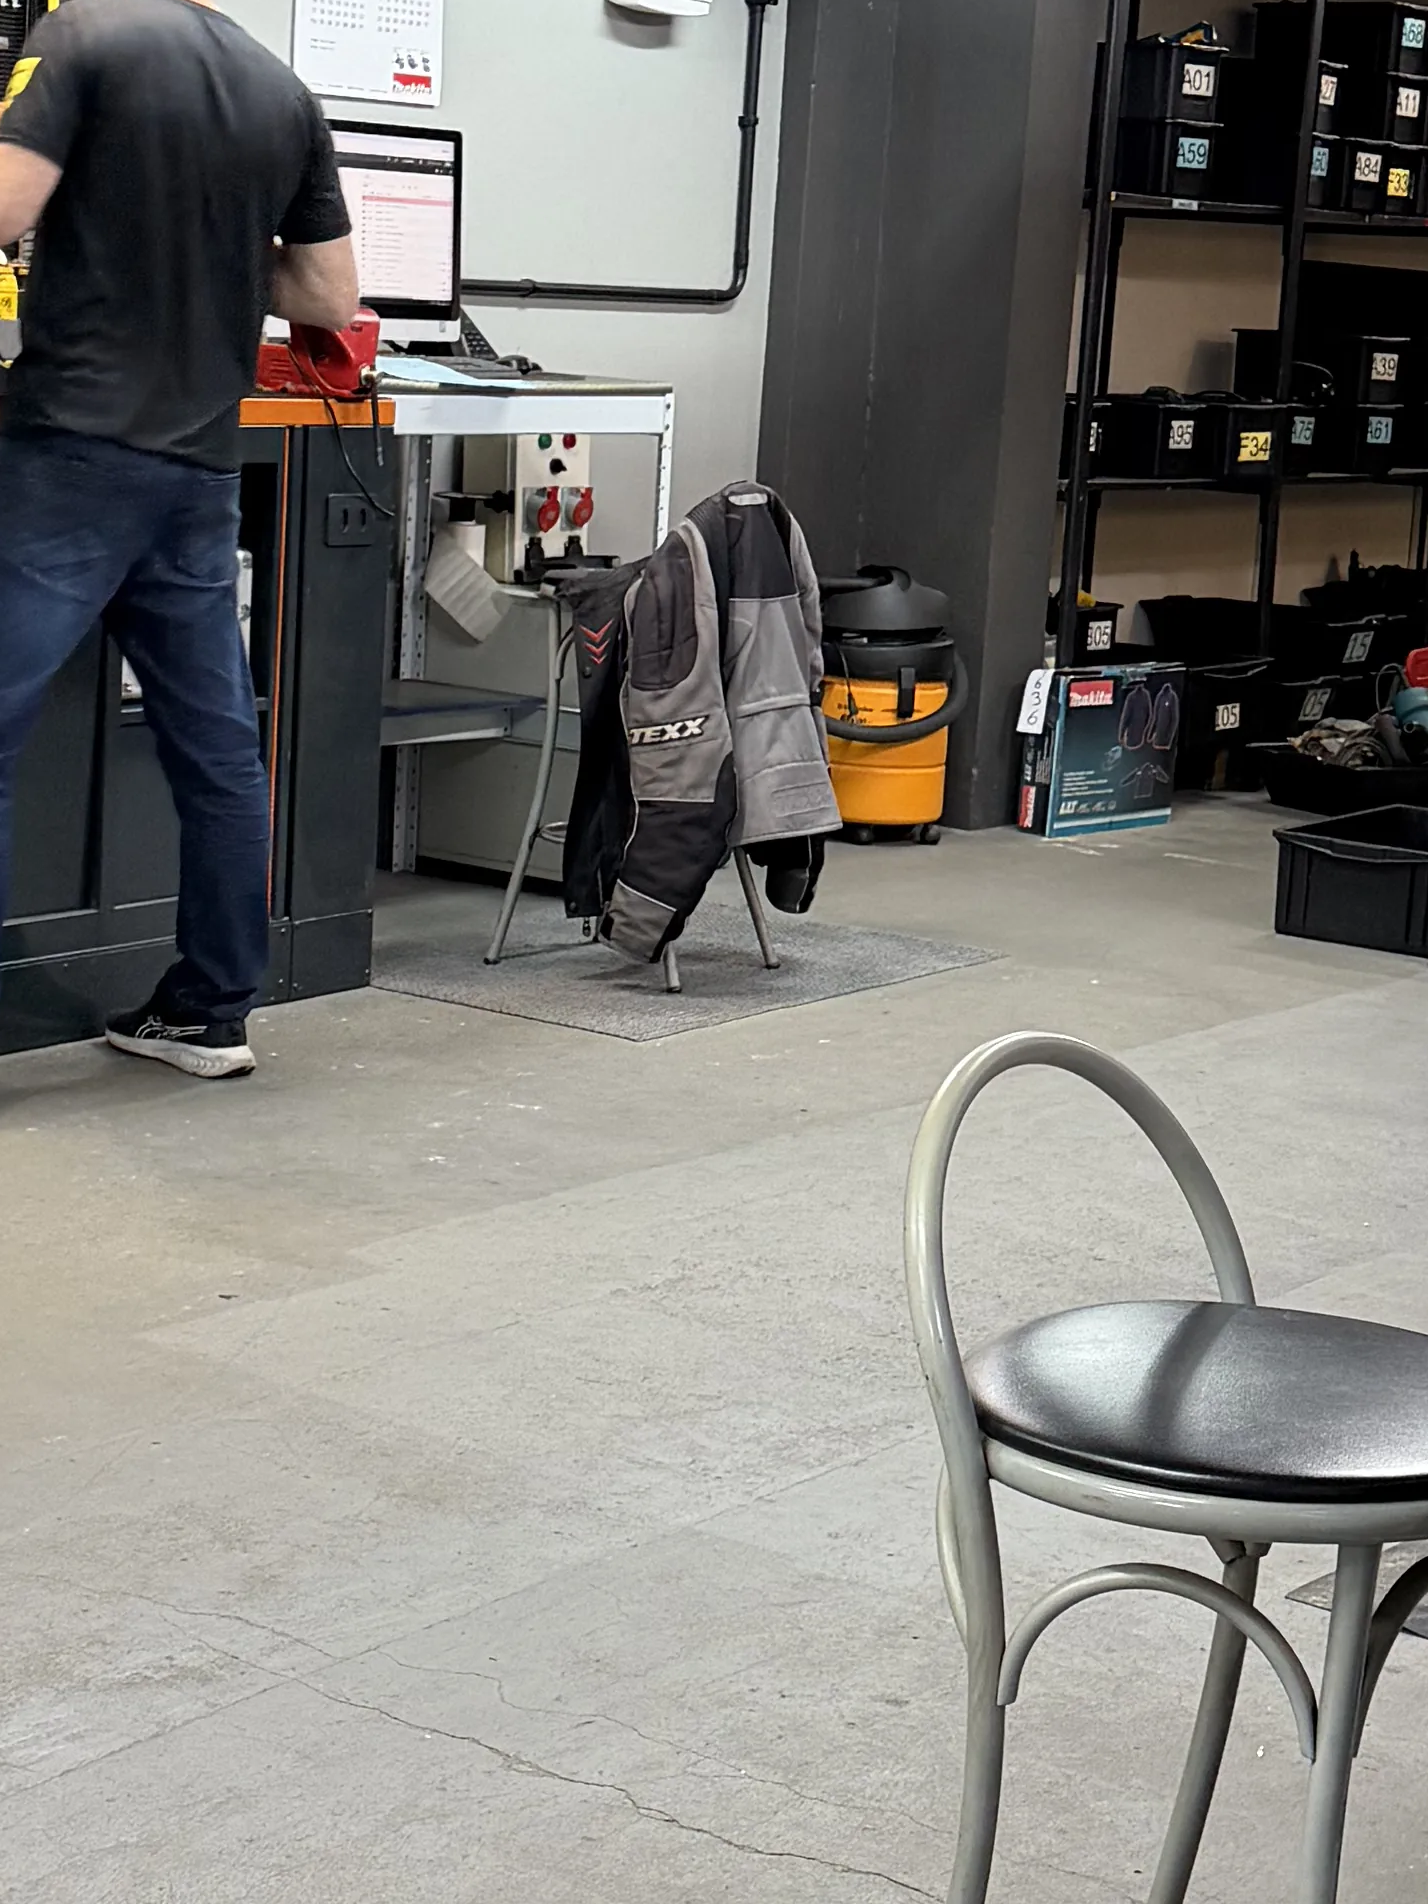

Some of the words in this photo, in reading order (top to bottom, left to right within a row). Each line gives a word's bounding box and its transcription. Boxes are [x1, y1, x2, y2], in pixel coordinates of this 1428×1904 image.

[1183, 69, 1212, 94] A01
[1178, 143, 1208, 166] A59
[629, 716, 707, 745] TEXX
